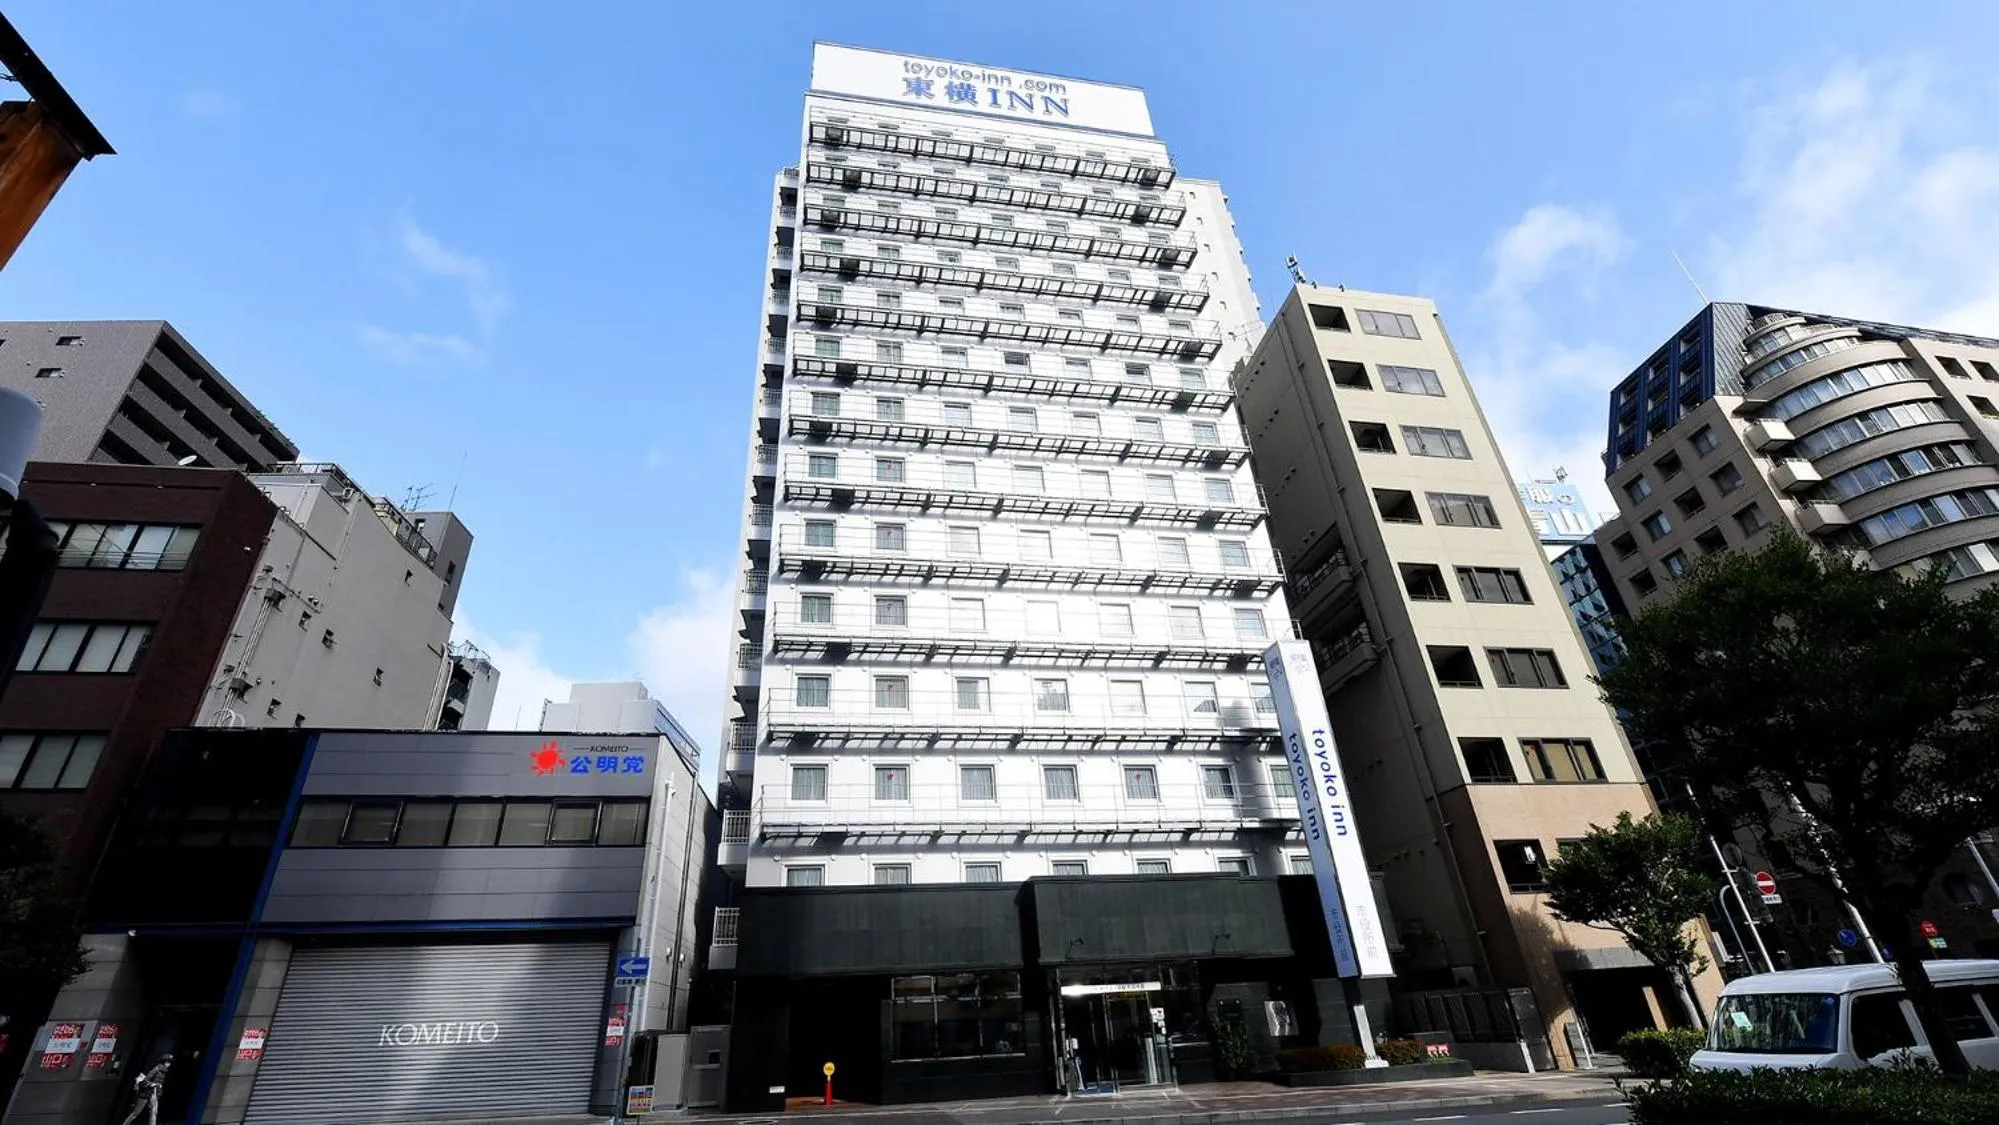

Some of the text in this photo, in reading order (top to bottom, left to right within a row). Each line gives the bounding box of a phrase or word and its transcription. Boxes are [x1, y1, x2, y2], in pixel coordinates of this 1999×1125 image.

[570, 755, 645, 774] 公明党
[1289, 732, 1321, 841] toyoko inn
[1311, 728, 1348, 837] toyoko inn
[378, 1020, 500, 1046] KOMEITO
